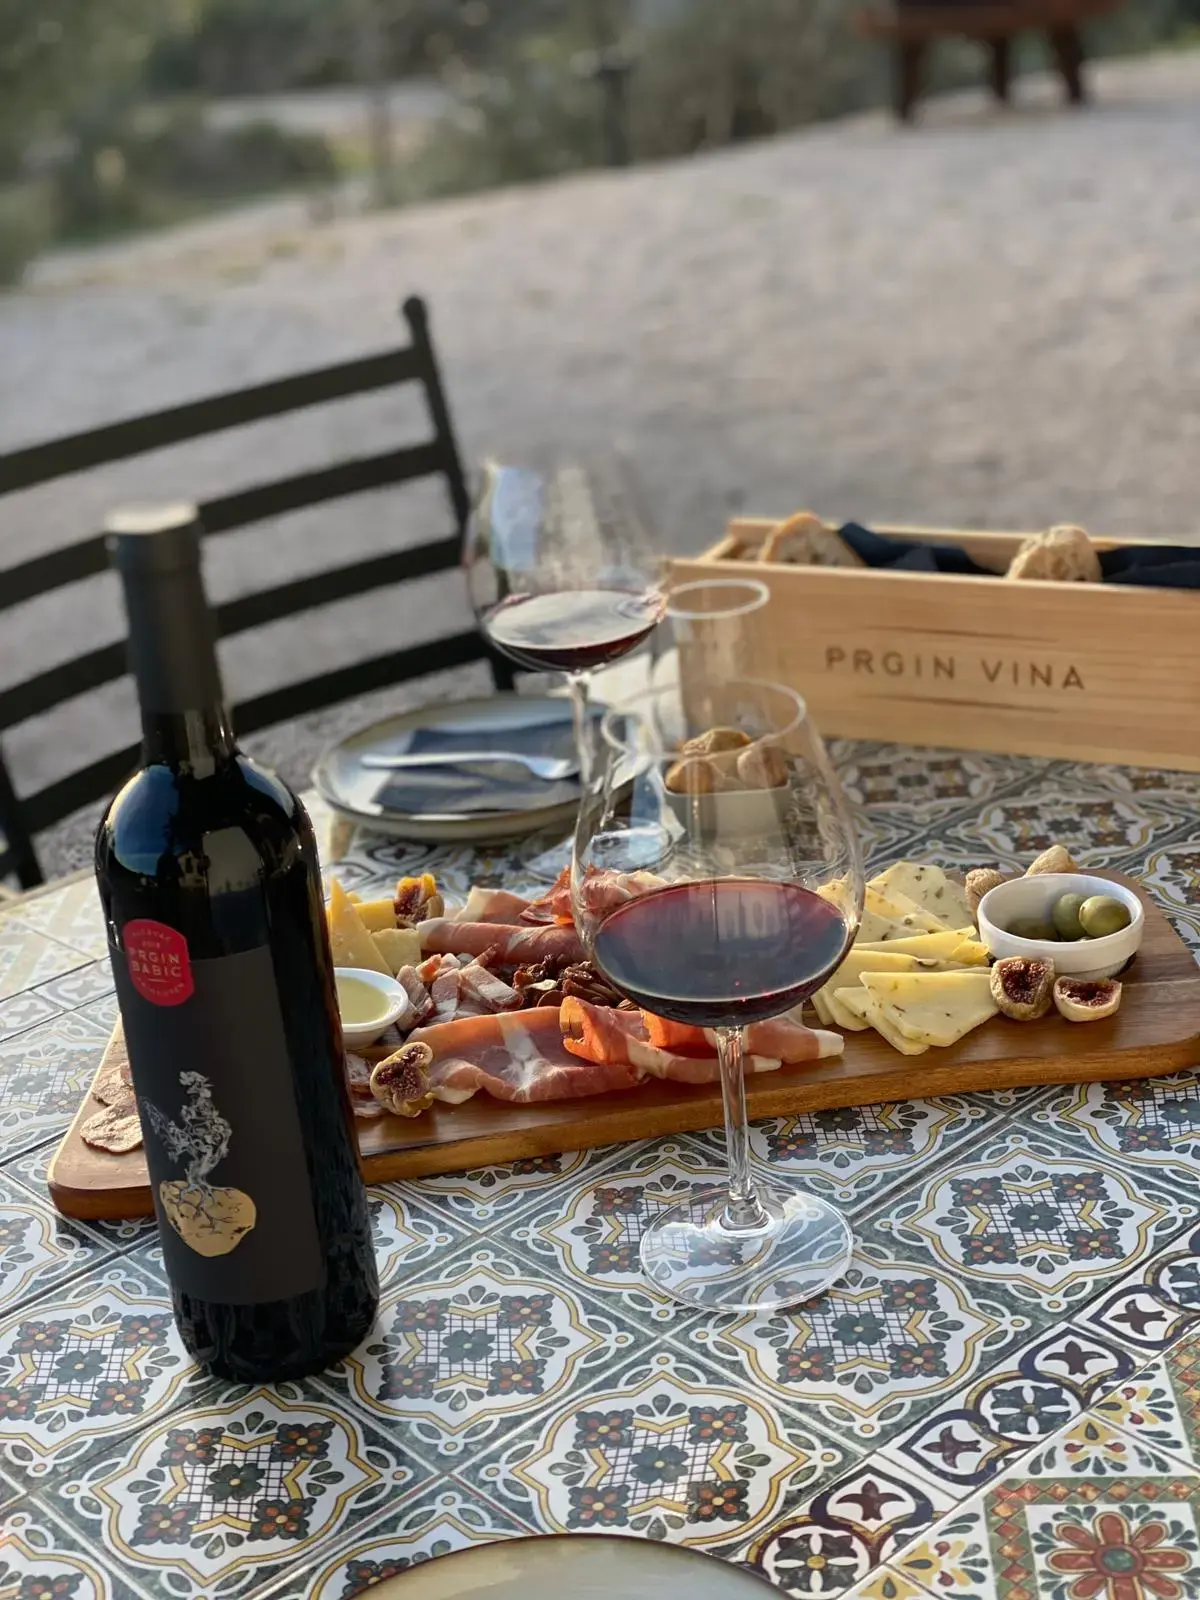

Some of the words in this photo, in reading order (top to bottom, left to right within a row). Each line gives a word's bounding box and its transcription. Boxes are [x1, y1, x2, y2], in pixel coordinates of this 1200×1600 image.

[825, 646, 955, 679] PRGIN
[981, 659, 1085, 690] VINA
[128, 946, 180, 964] PRGIN
